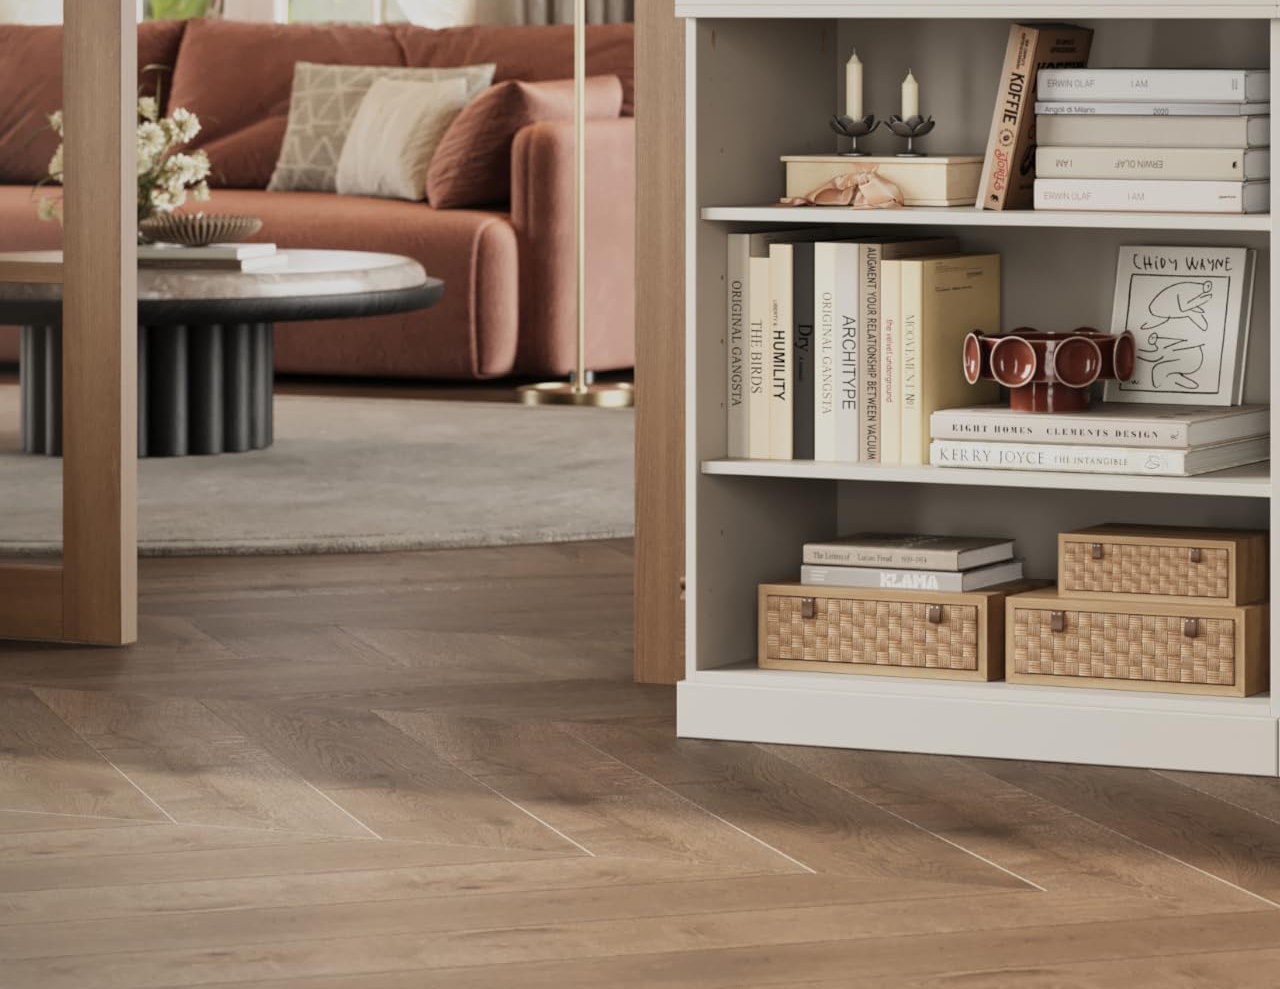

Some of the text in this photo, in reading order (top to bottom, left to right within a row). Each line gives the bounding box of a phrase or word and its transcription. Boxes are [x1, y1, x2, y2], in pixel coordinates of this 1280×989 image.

[1003, 71, 1025, 126] KOFFIE
[1047, 79, 1096, 88] ERWIN OLAF
[1115, 160, 1164, 169] ERWIN OLAF
[1186, 257, 1233, 271] WAYNE
[731, 280, 743, 407] ORIGINAL GANGSTA
[750, 320, 762, 394] THE BIRDS
[794, 324, 813, 352] Dry
[821, 292, 832, 415] ORIGINAL GANGSTA
[866, 247, 877, 460] AUGMENT YOUR RELATIONSHIP BETWEEN VACUUM
[773, 330, 785, 401] HUMILITY
[842, 315, 856, 410] ARCHITYPE
[885, 319, 894, 403] the velvet underground
[952, 423, 1034, 435] EIGHT HOMES
[1046, 427, 1159, 440] CLEMENTS DESIGN
[939, 448, 1128, 467] KERRY JOYCE THE INTANGIBLE
[880, 571, 939, 589] KLAMA
